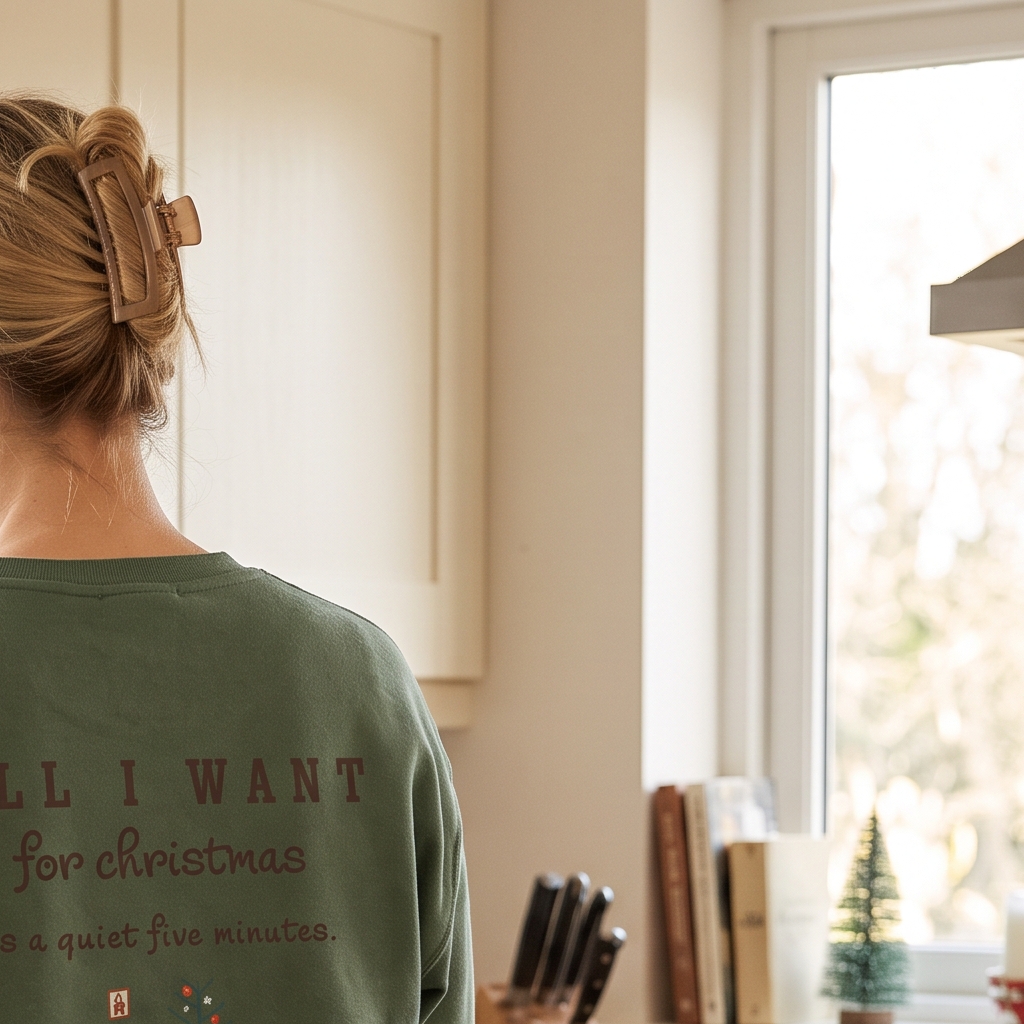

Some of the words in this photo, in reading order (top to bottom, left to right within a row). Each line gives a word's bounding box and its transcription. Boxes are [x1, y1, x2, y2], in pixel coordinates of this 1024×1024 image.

[120, 760, 139, 806] I
[185, 757, 365, 805] WANT
[12, 830, 84, 893] for
[96, 826, 307, 880] christmas
[29, 933, 48, 952] a
[58, 922, 140, 960] quiet
[146, 913, 204, 955] five
[214, 917, 337, 946] minutes.
